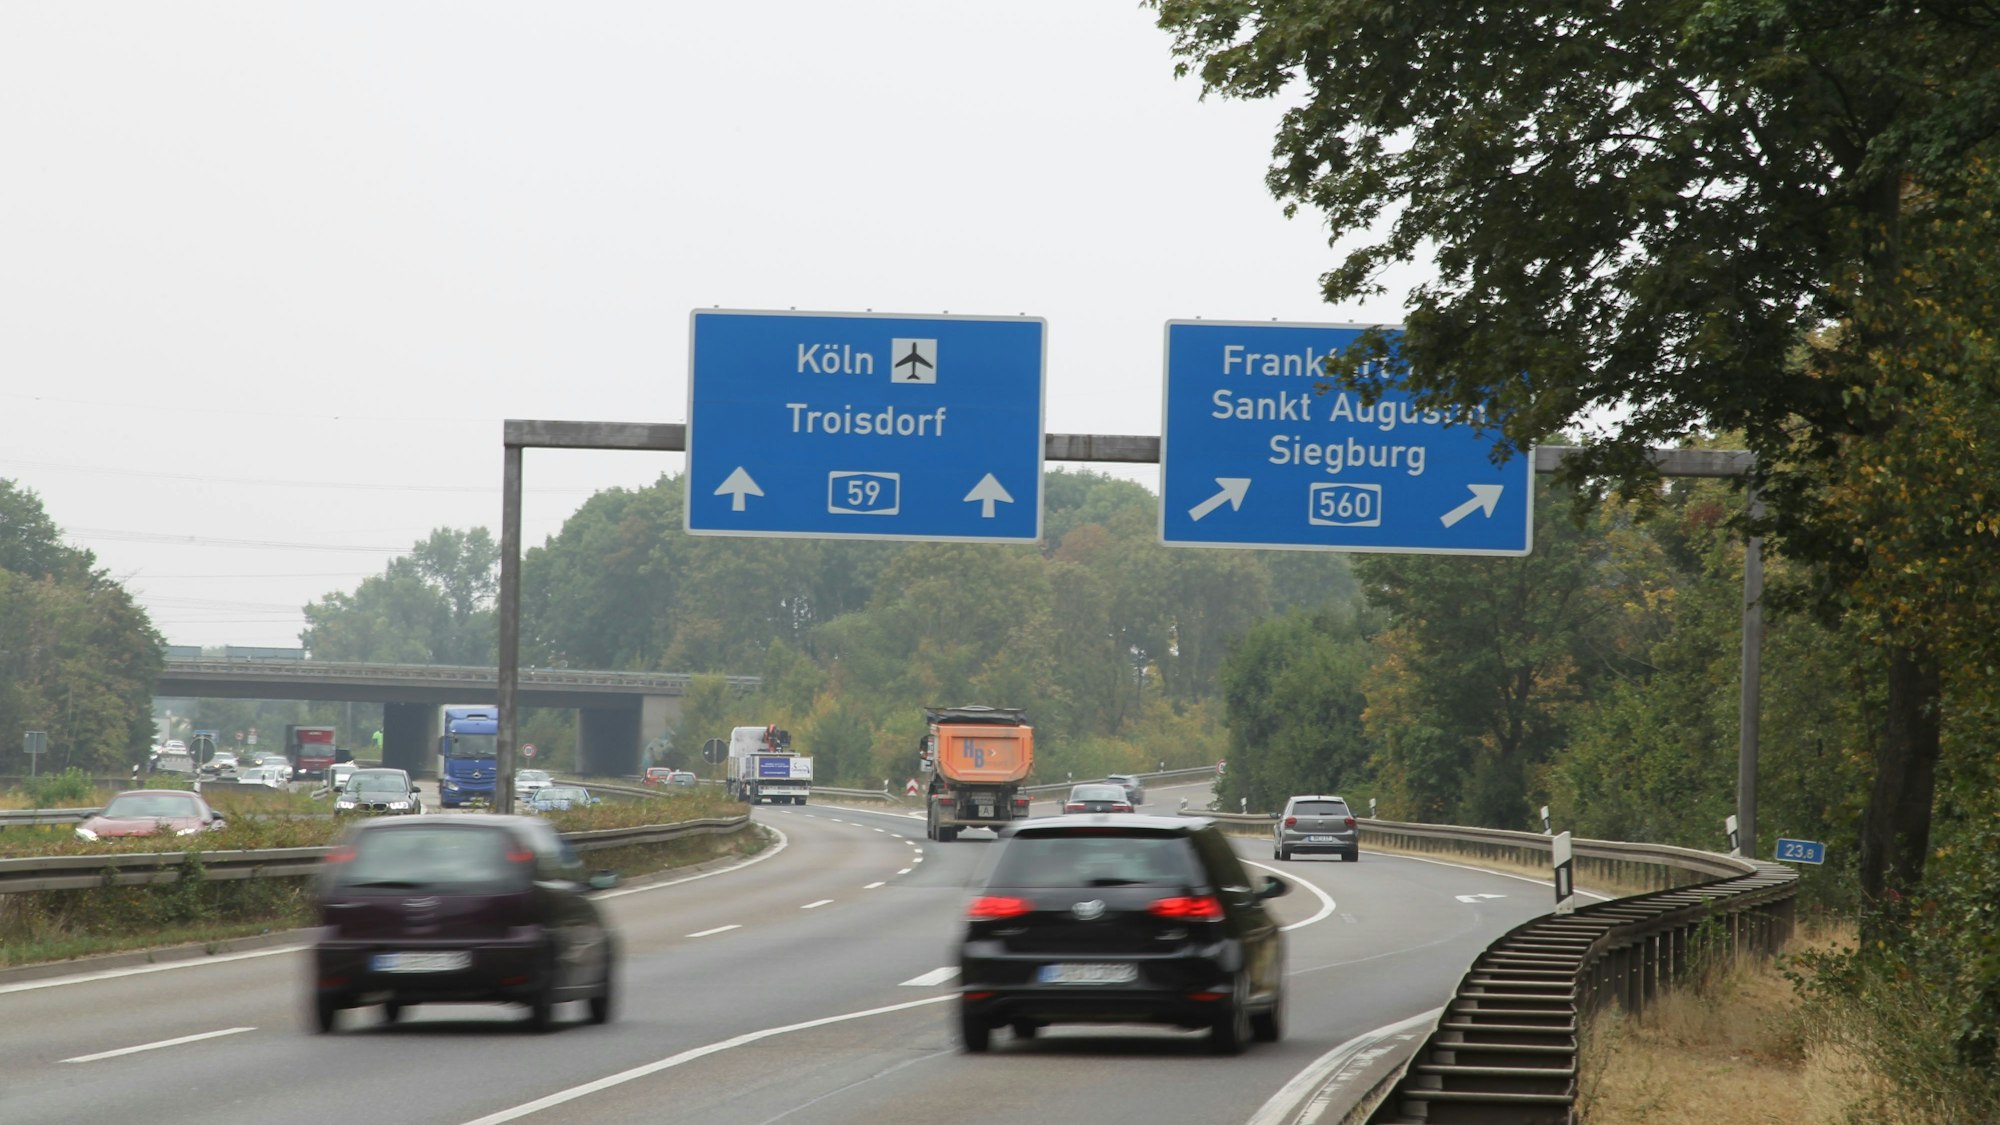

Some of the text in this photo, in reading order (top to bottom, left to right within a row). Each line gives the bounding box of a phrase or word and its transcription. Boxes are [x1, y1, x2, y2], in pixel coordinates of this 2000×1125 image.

[797, 343, 874, 374] Köln
[786, 403, 947, 437] Troisdorf
[1211, 388, 1312, 421] Sankt
[1268, 434, 1426, 476] Siegburg
[847, 480, 881, 506] 59
[1319, 491, 1371, 518] 560
